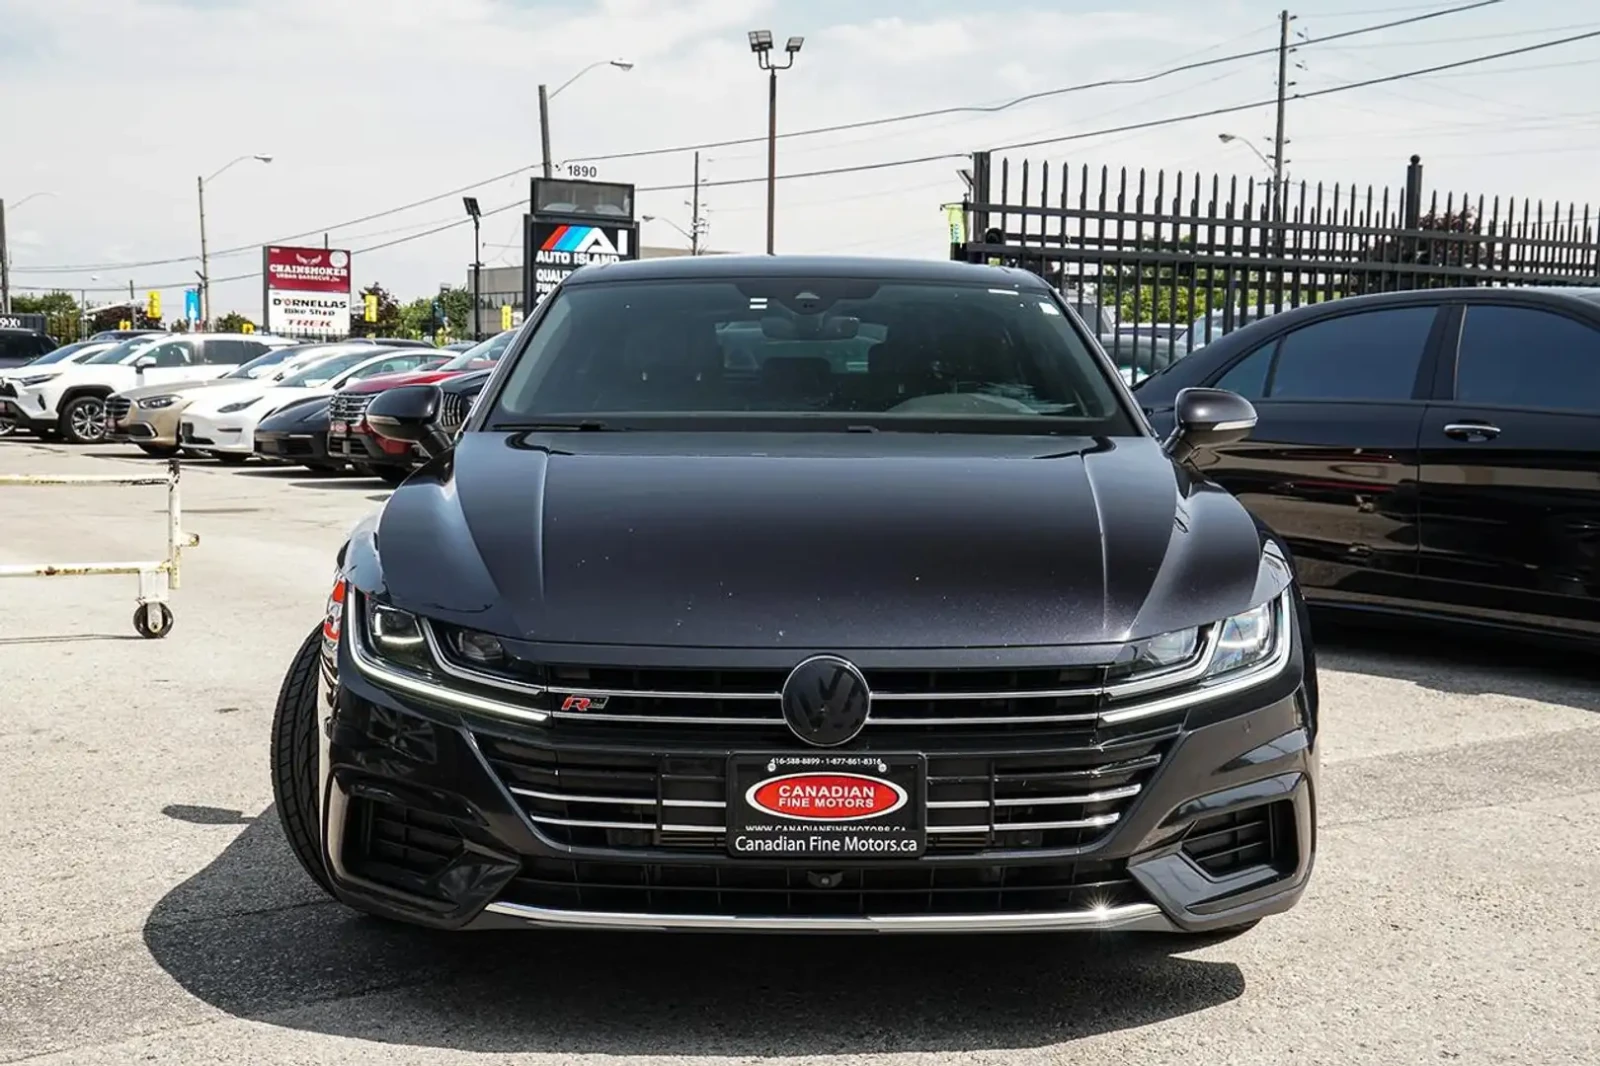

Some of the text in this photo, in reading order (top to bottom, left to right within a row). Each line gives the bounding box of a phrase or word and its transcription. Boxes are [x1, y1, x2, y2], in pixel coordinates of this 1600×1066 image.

[567, 165, 597, 178] 1890
[536, 250, 620, 265] AUTO ISLAND
[269, 264, 347, 277] CHAINSMOKER
[309, 308, 335, 316] Shop
[286, 319, 331, 327] TREK
[778, 785, 875, 798] CANADIAN
[778, 797, 875, 808] FINE MOTORS
[735, 835, 918, 852] Canadian Fine Motors.ca
